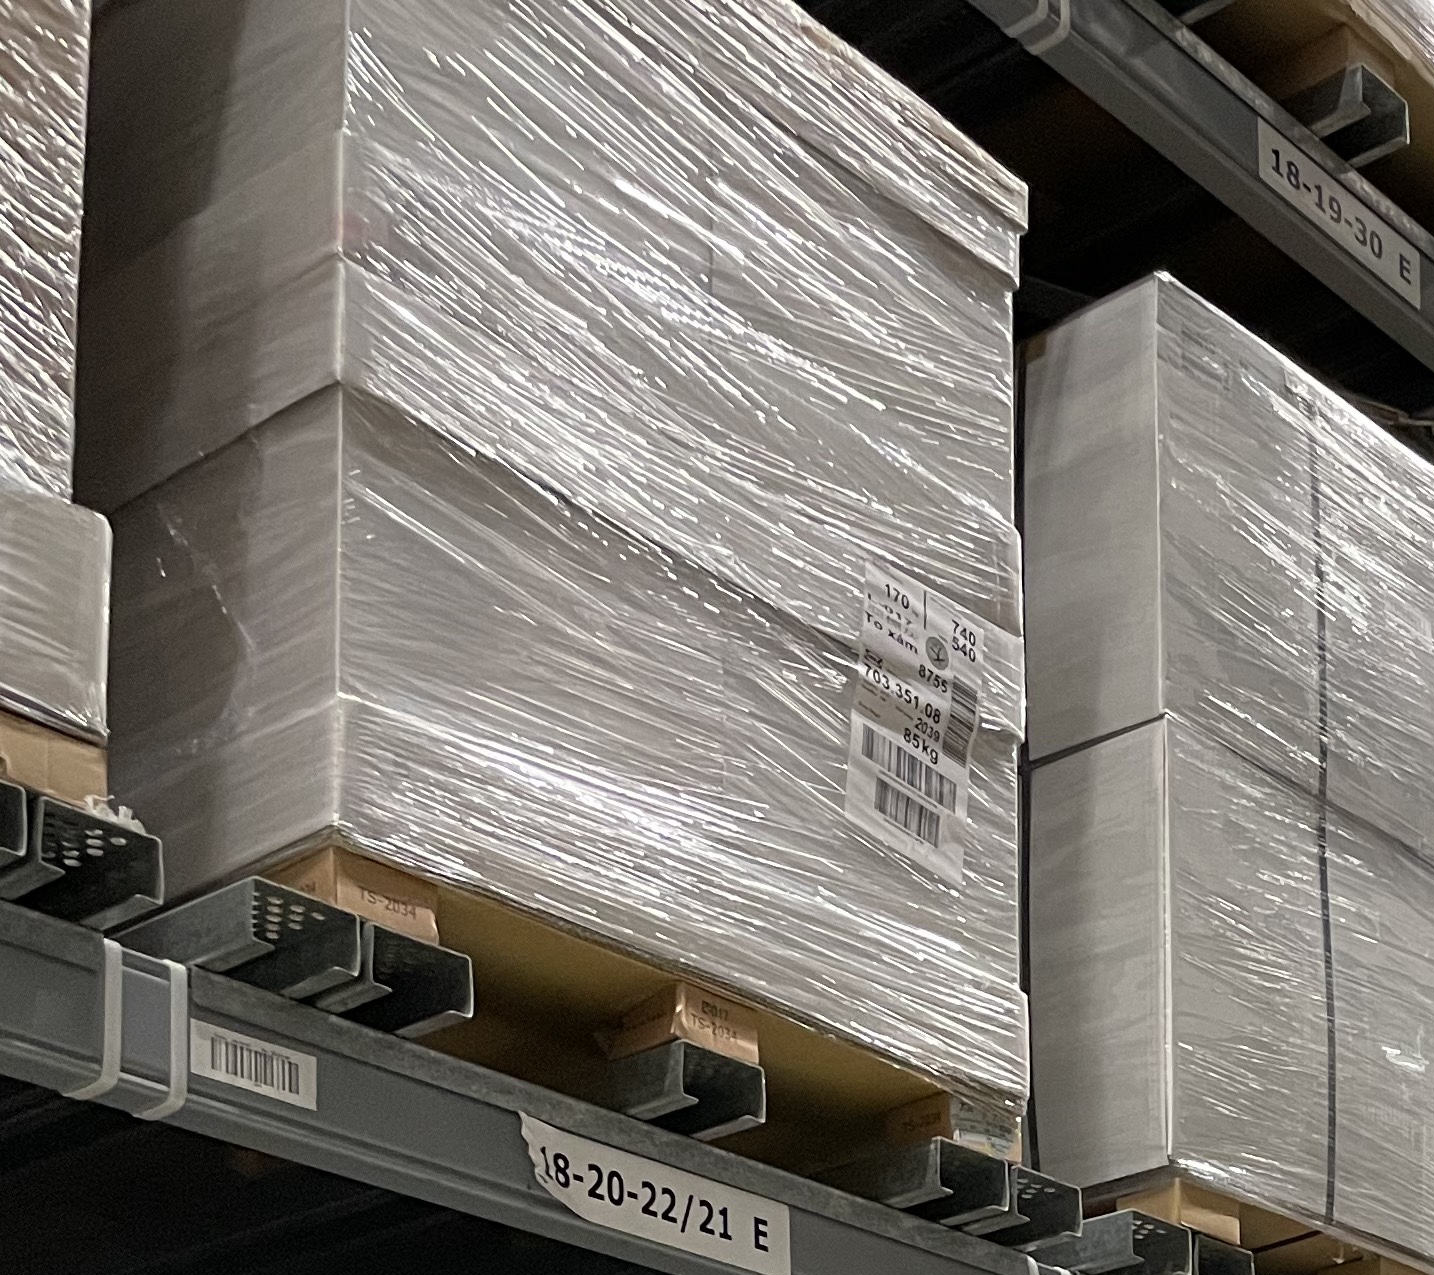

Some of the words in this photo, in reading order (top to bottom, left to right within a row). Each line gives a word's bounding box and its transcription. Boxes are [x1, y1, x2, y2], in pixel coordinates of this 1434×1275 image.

[1271, 148, 1383, 260] 18-19-30
[1399, 253, 1412, 286] E
[884, 583, 910, 610] 170
[951, 618, 977, 647] 740
[951, 636, 977, 663] 540
[863, 662, 942, 725] 703.351.08
[918, 664, 948, 693] 8755
[903, 727, 939, 765] 85kg
[914, 717, 941, 744] 2039
[360, 887, 418, 920] TS-2034
[540, 1145, 733, 1241] 18-20-22/21
[753, 1216, 769, 1253] E
